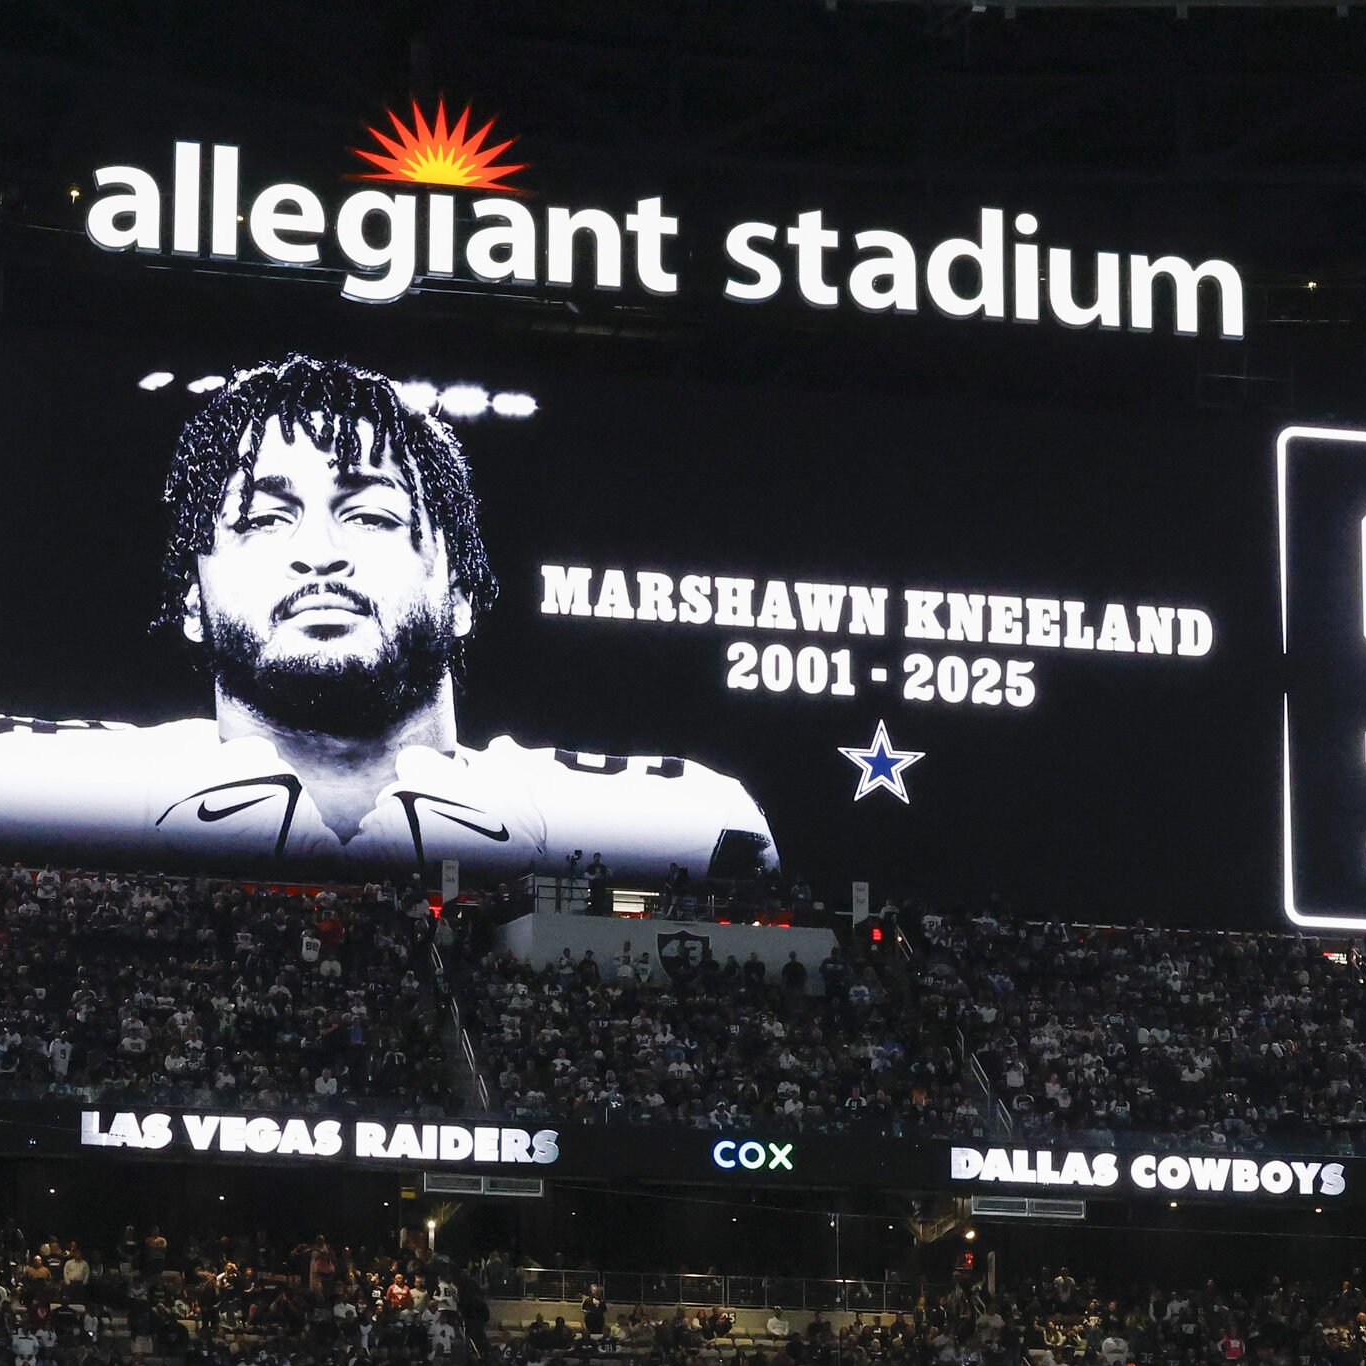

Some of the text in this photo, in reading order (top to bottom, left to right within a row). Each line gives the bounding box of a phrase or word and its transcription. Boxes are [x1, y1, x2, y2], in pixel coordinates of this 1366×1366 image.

[86, 140, 1246, 340] allegiant stadium
[541, 564, 1214, 659] MARSHAWN KNEELAND
[726, 641, 856, 697] 2001
[902, 652, 1036, 708] 2025
[80, 1110, 559, 1164] LAS VEGAS RAIDERS
[711, 1140, 794, 1171] COX
[950, 1146, 1346, 1196] DALLAS COWBOYS
